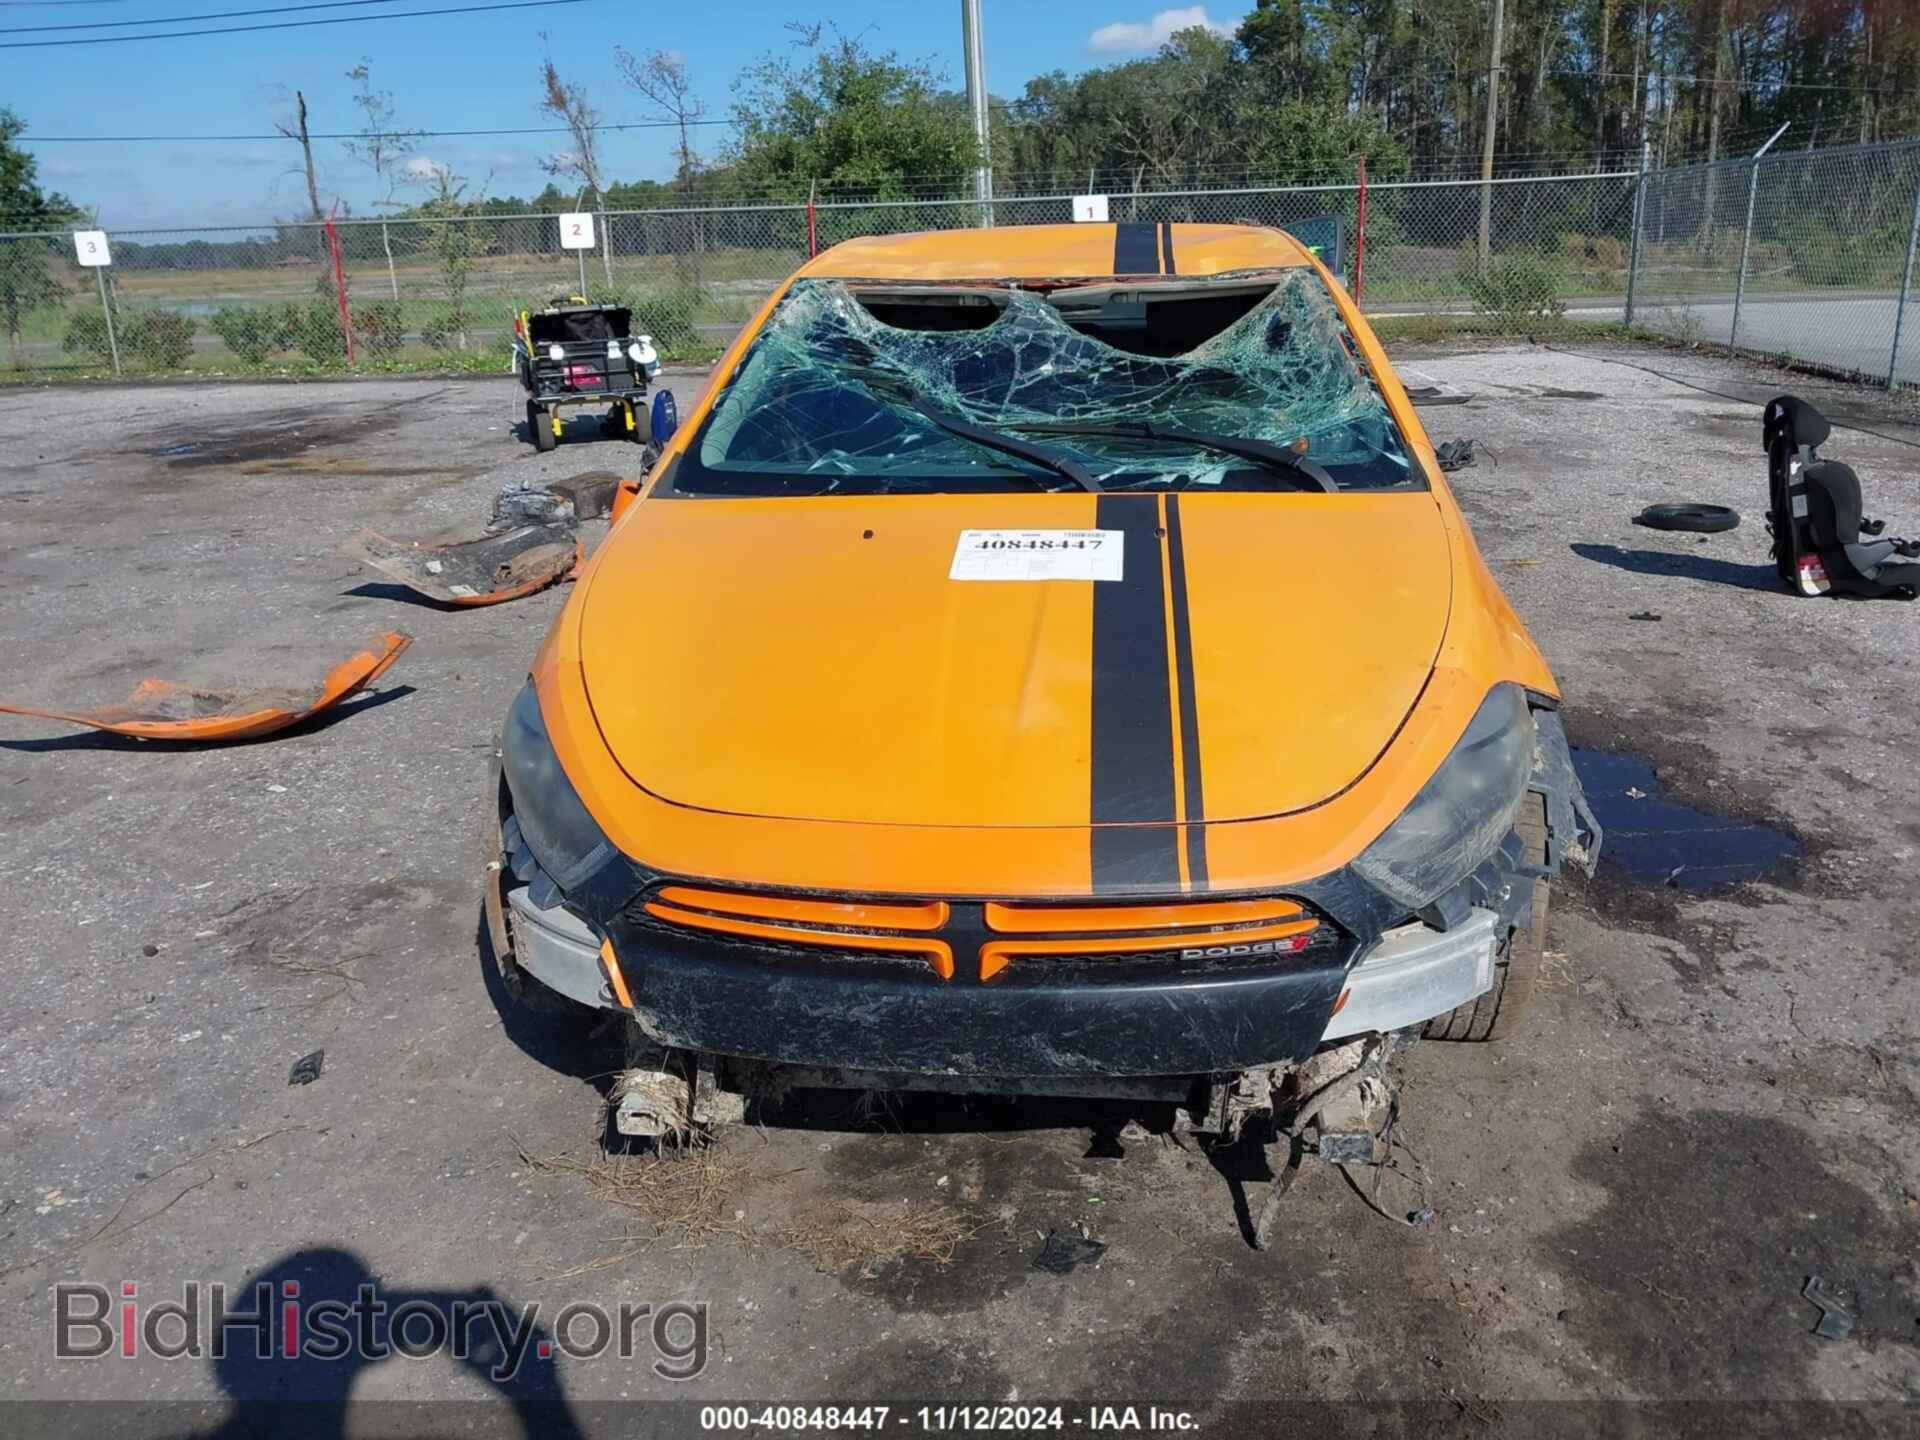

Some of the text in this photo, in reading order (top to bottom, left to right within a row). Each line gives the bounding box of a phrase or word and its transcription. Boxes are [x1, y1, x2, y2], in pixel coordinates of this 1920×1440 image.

[1086, 206, 1094, 218] 1
[571, 223, 582, 236] 2
[87, 241, 97, 253] 3
[975, 539, 1102, 550] 40848447
[1181, 940, 1294, 960] DODGE
